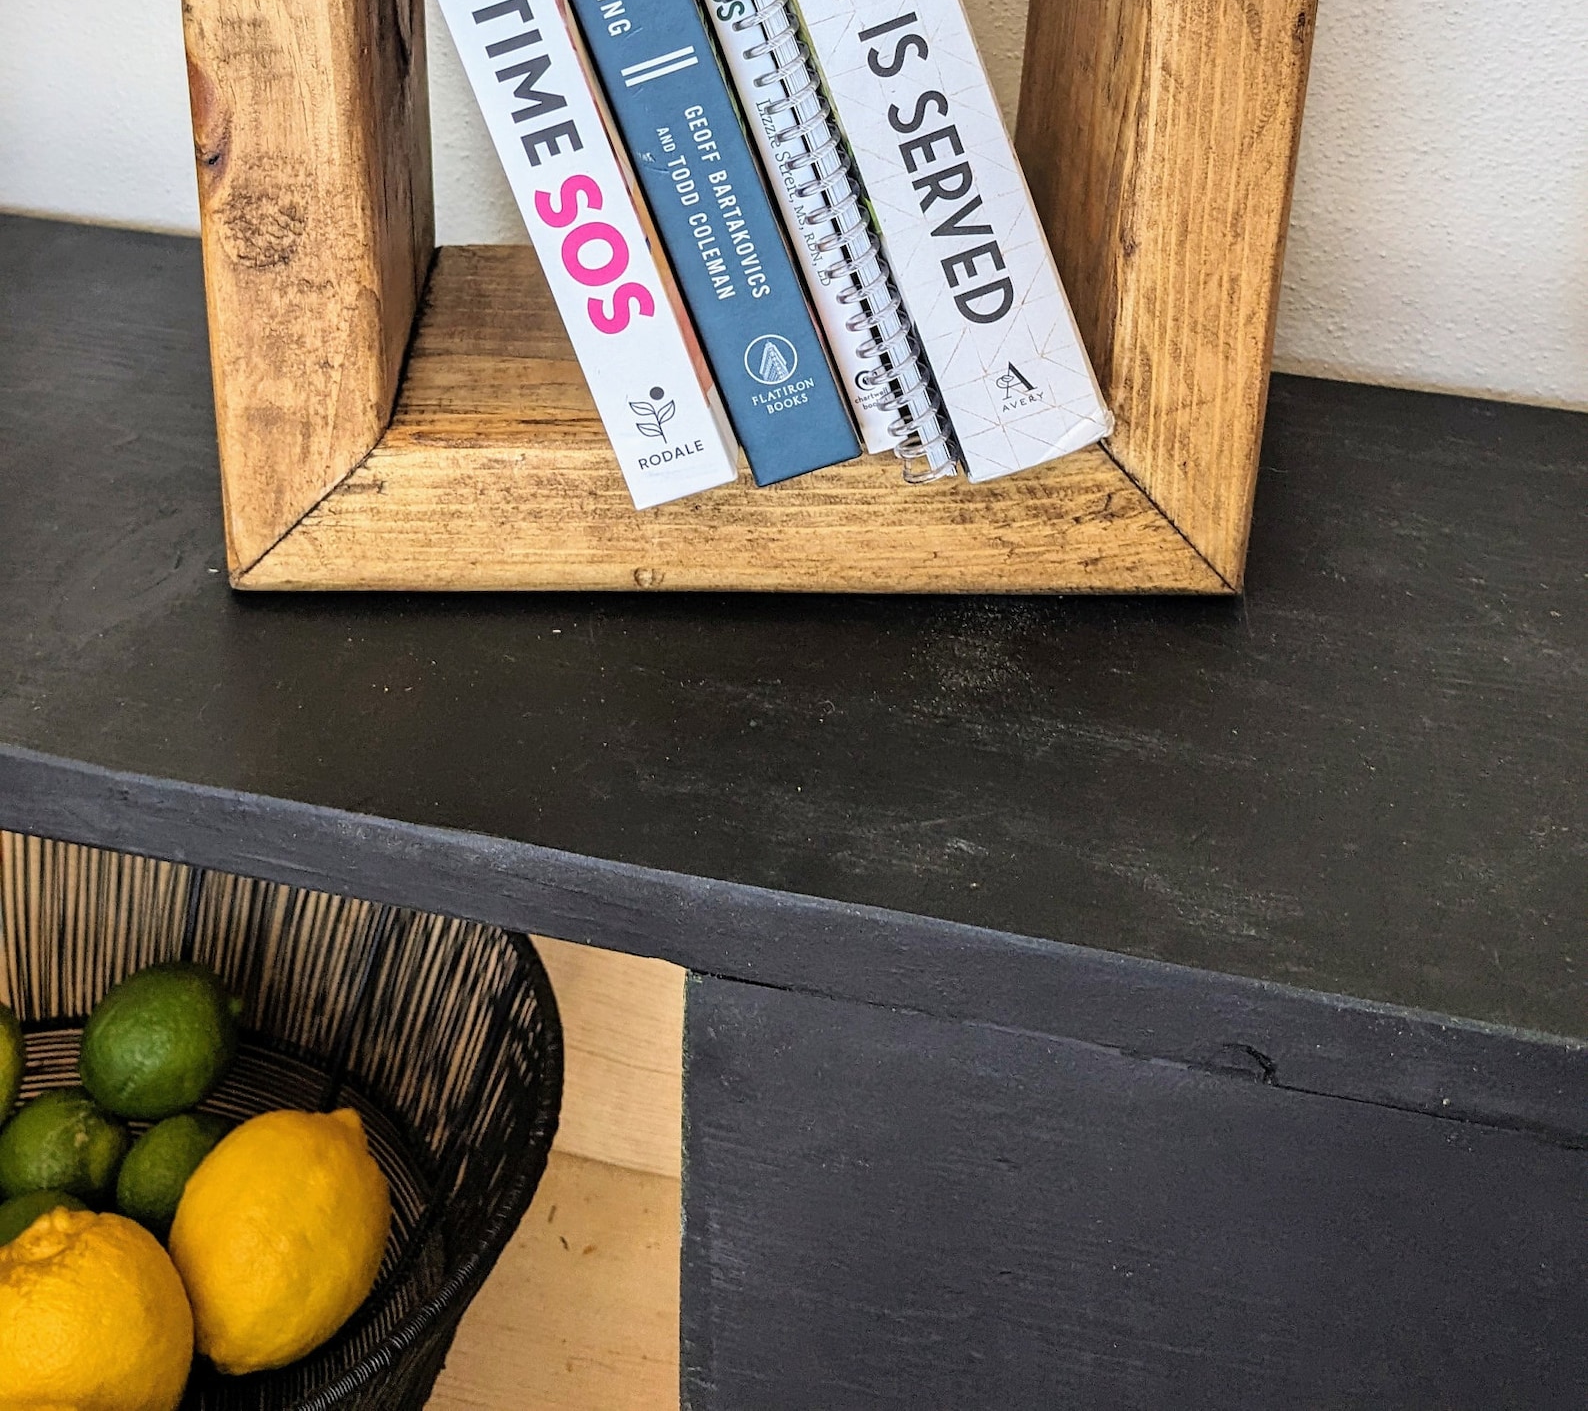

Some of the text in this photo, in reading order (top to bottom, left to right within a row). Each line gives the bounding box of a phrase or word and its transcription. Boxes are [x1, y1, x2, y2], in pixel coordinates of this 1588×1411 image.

[857, 10, 929, 79] IS
[656, 126, 736, 300] AND TODD COLEMAN
[684, 105, 770, 299] GEOFF BARTAKOVICS
[887, 89, 1015, 326] SERVED
[535, 174, 654, 334] SOS
[817, 270, 831, 287] LD
[751, 378, 815, 409] FLATIRON
[766, 393, 809, 415] BOOKS
[1002, 391, 1045, 414] AVERY
[638, 439, 705, 470] RODALE
